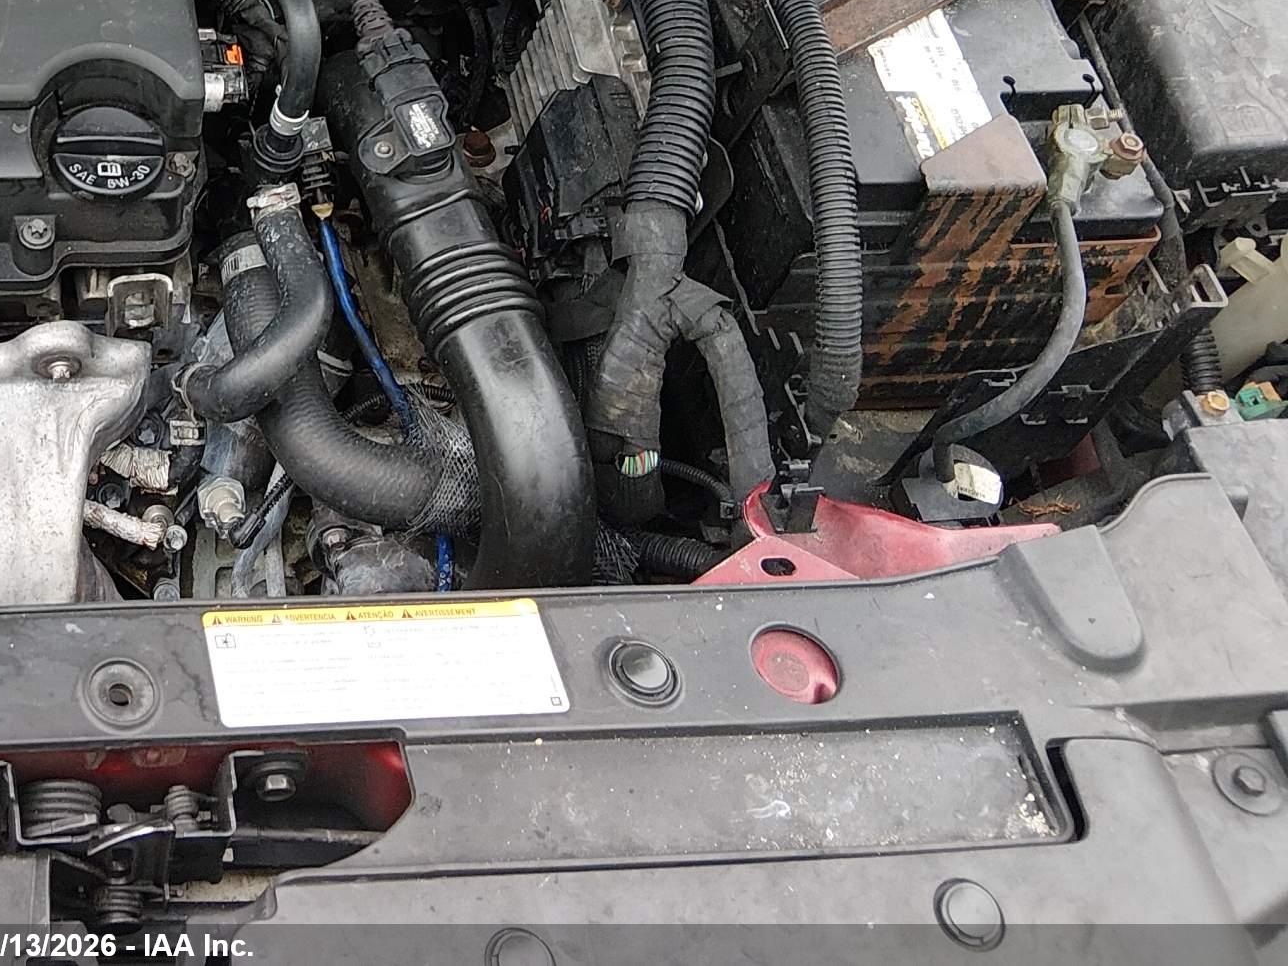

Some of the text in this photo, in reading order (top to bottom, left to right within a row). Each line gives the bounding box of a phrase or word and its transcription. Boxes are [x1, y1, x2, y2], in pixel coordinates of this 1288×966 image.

[69, 163, 150, 189] SAE 5W-30
[224, 614, 264, 624] WARNING
